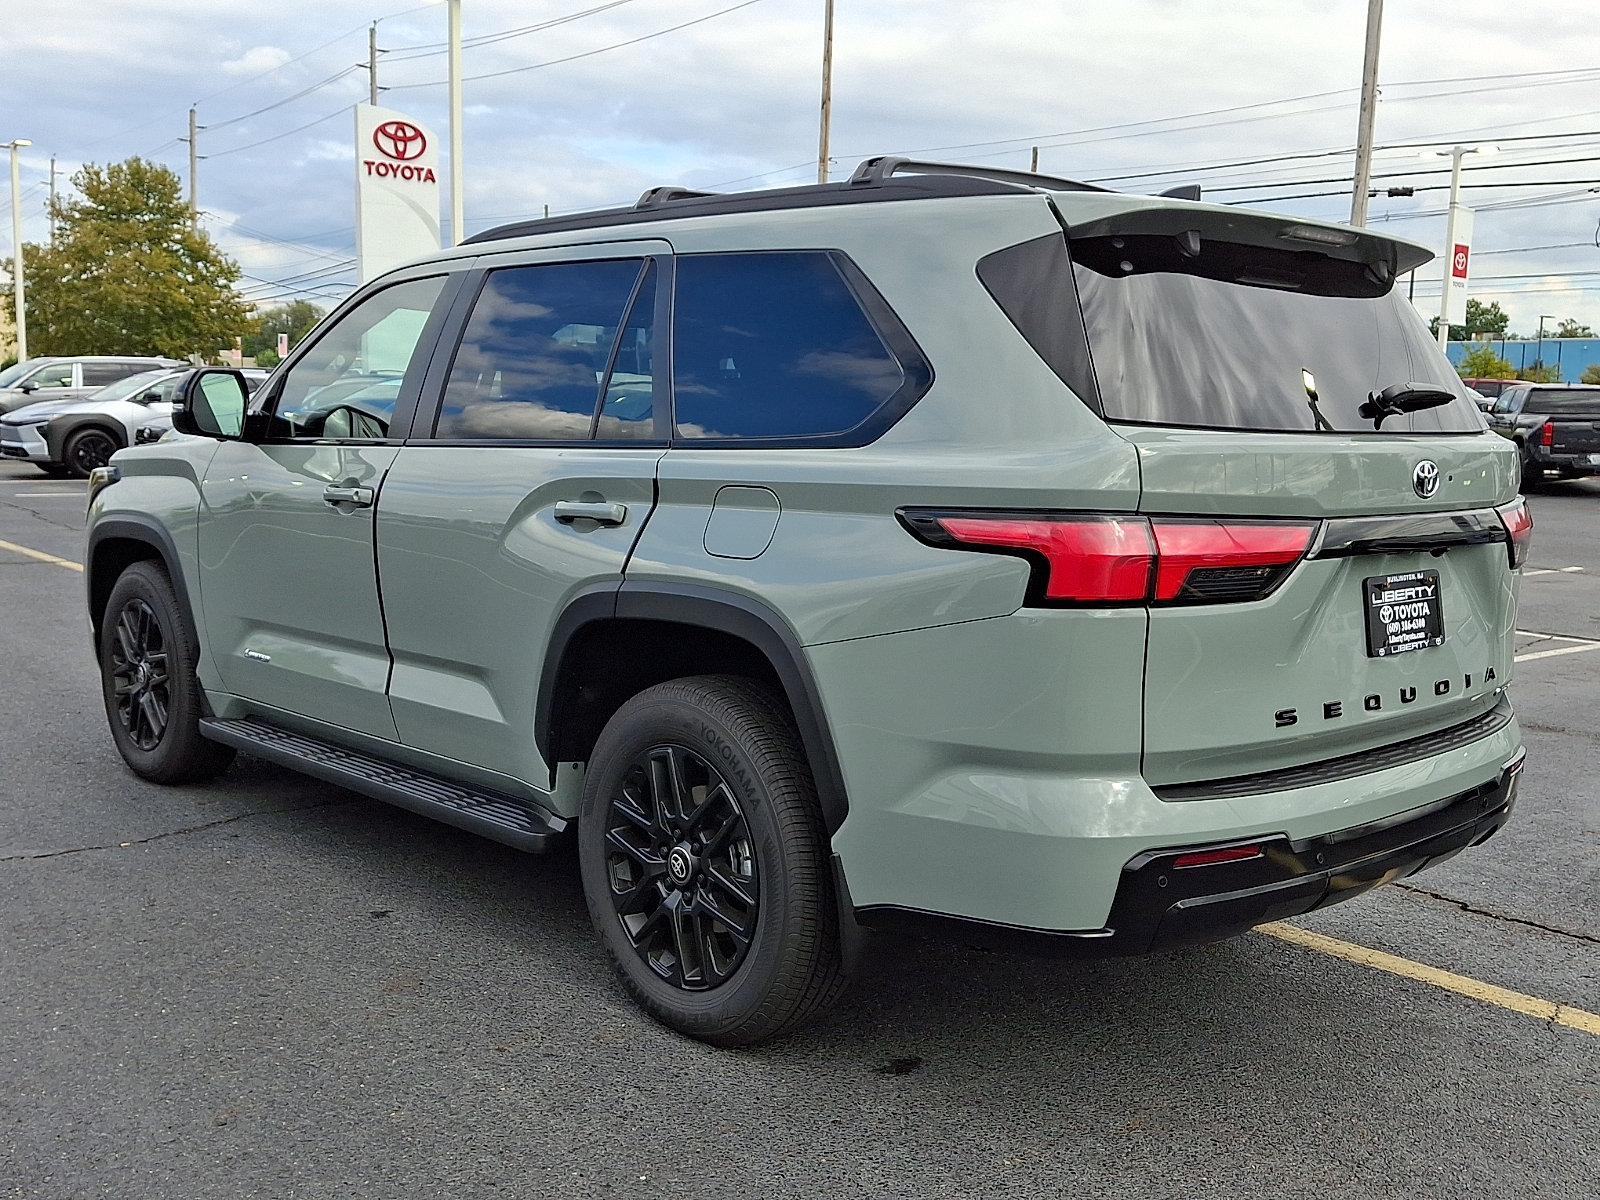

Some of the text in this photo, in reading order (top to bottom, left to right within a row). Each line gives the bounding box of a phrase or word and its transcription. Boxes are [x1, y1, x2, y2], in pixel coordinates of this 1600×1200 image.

[363, 160, 436, 183] TOYOTA
[1371, 584, 1436, 604] LIBERTY
[1394, 601, 1430, 620] TOYOTA
[1391, 640, 1430, 653] LIBERTY
[1275, 666, 1496, 728] SEQUOIA
[699, 721, 762, 812] YOKOHAMA
